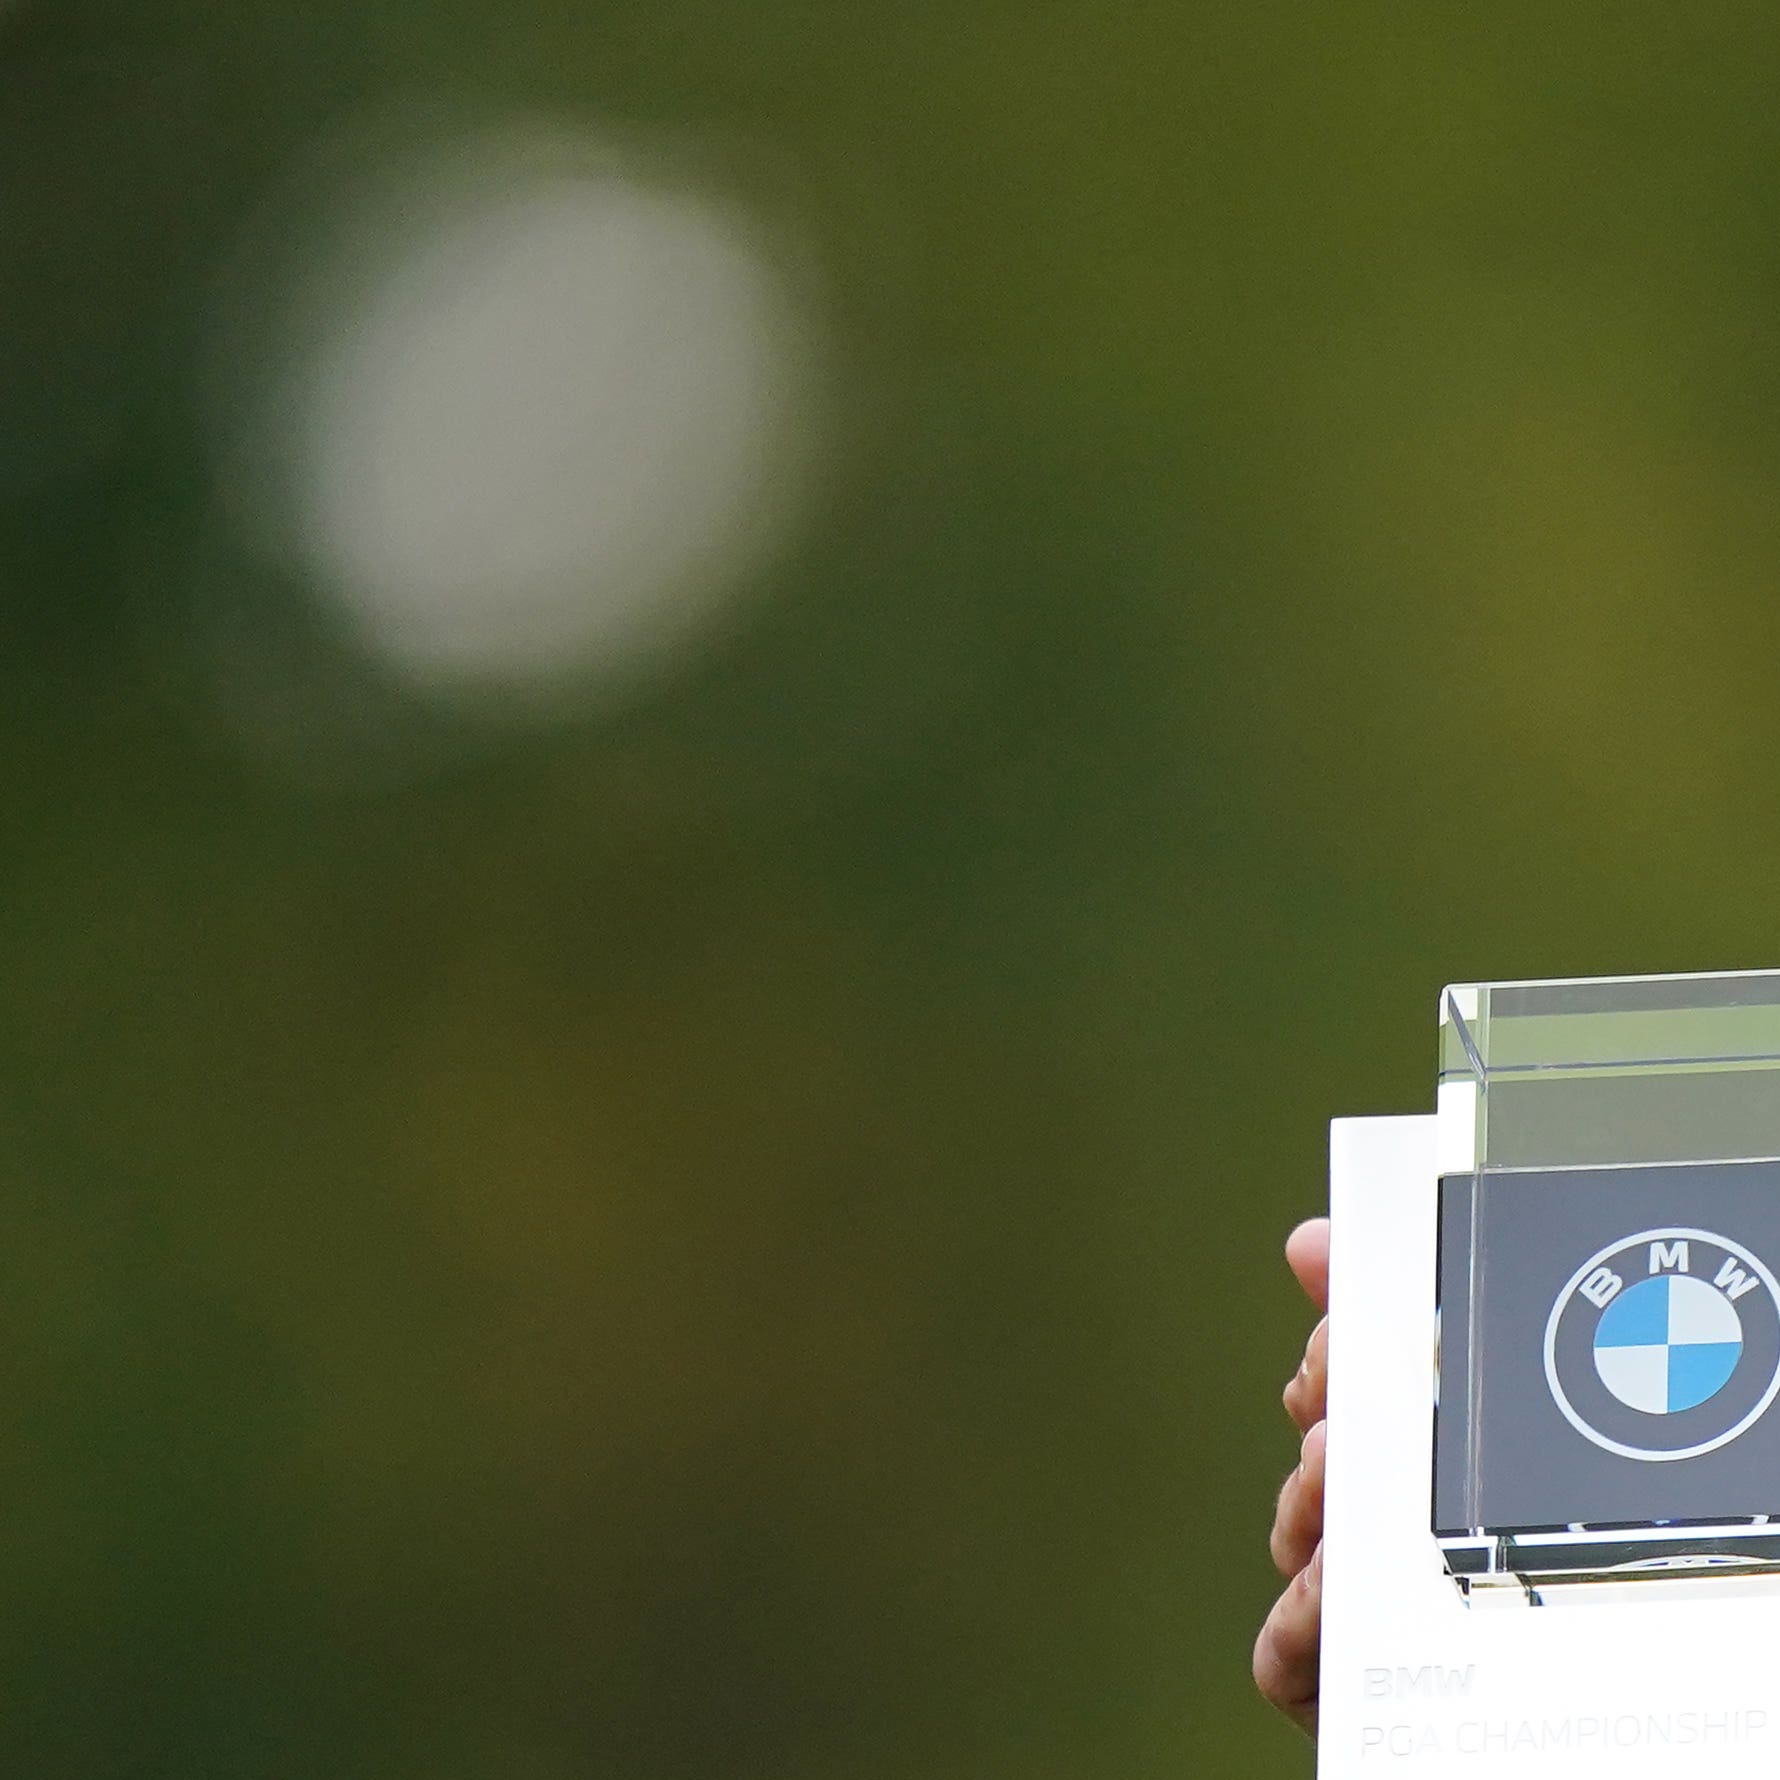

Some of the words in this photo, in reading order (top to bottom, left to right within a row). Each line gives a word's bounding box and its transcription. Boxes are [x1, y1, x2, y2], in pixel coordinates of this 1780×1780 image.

[1579, 1241, 1759, 1309] BMW
[1363, 1664, 1476, 1700] BMW
[1362, 1724, 1443, 1757] PGA
[1456, 1709, 1768, 1754] CHAMPIONSHIP
